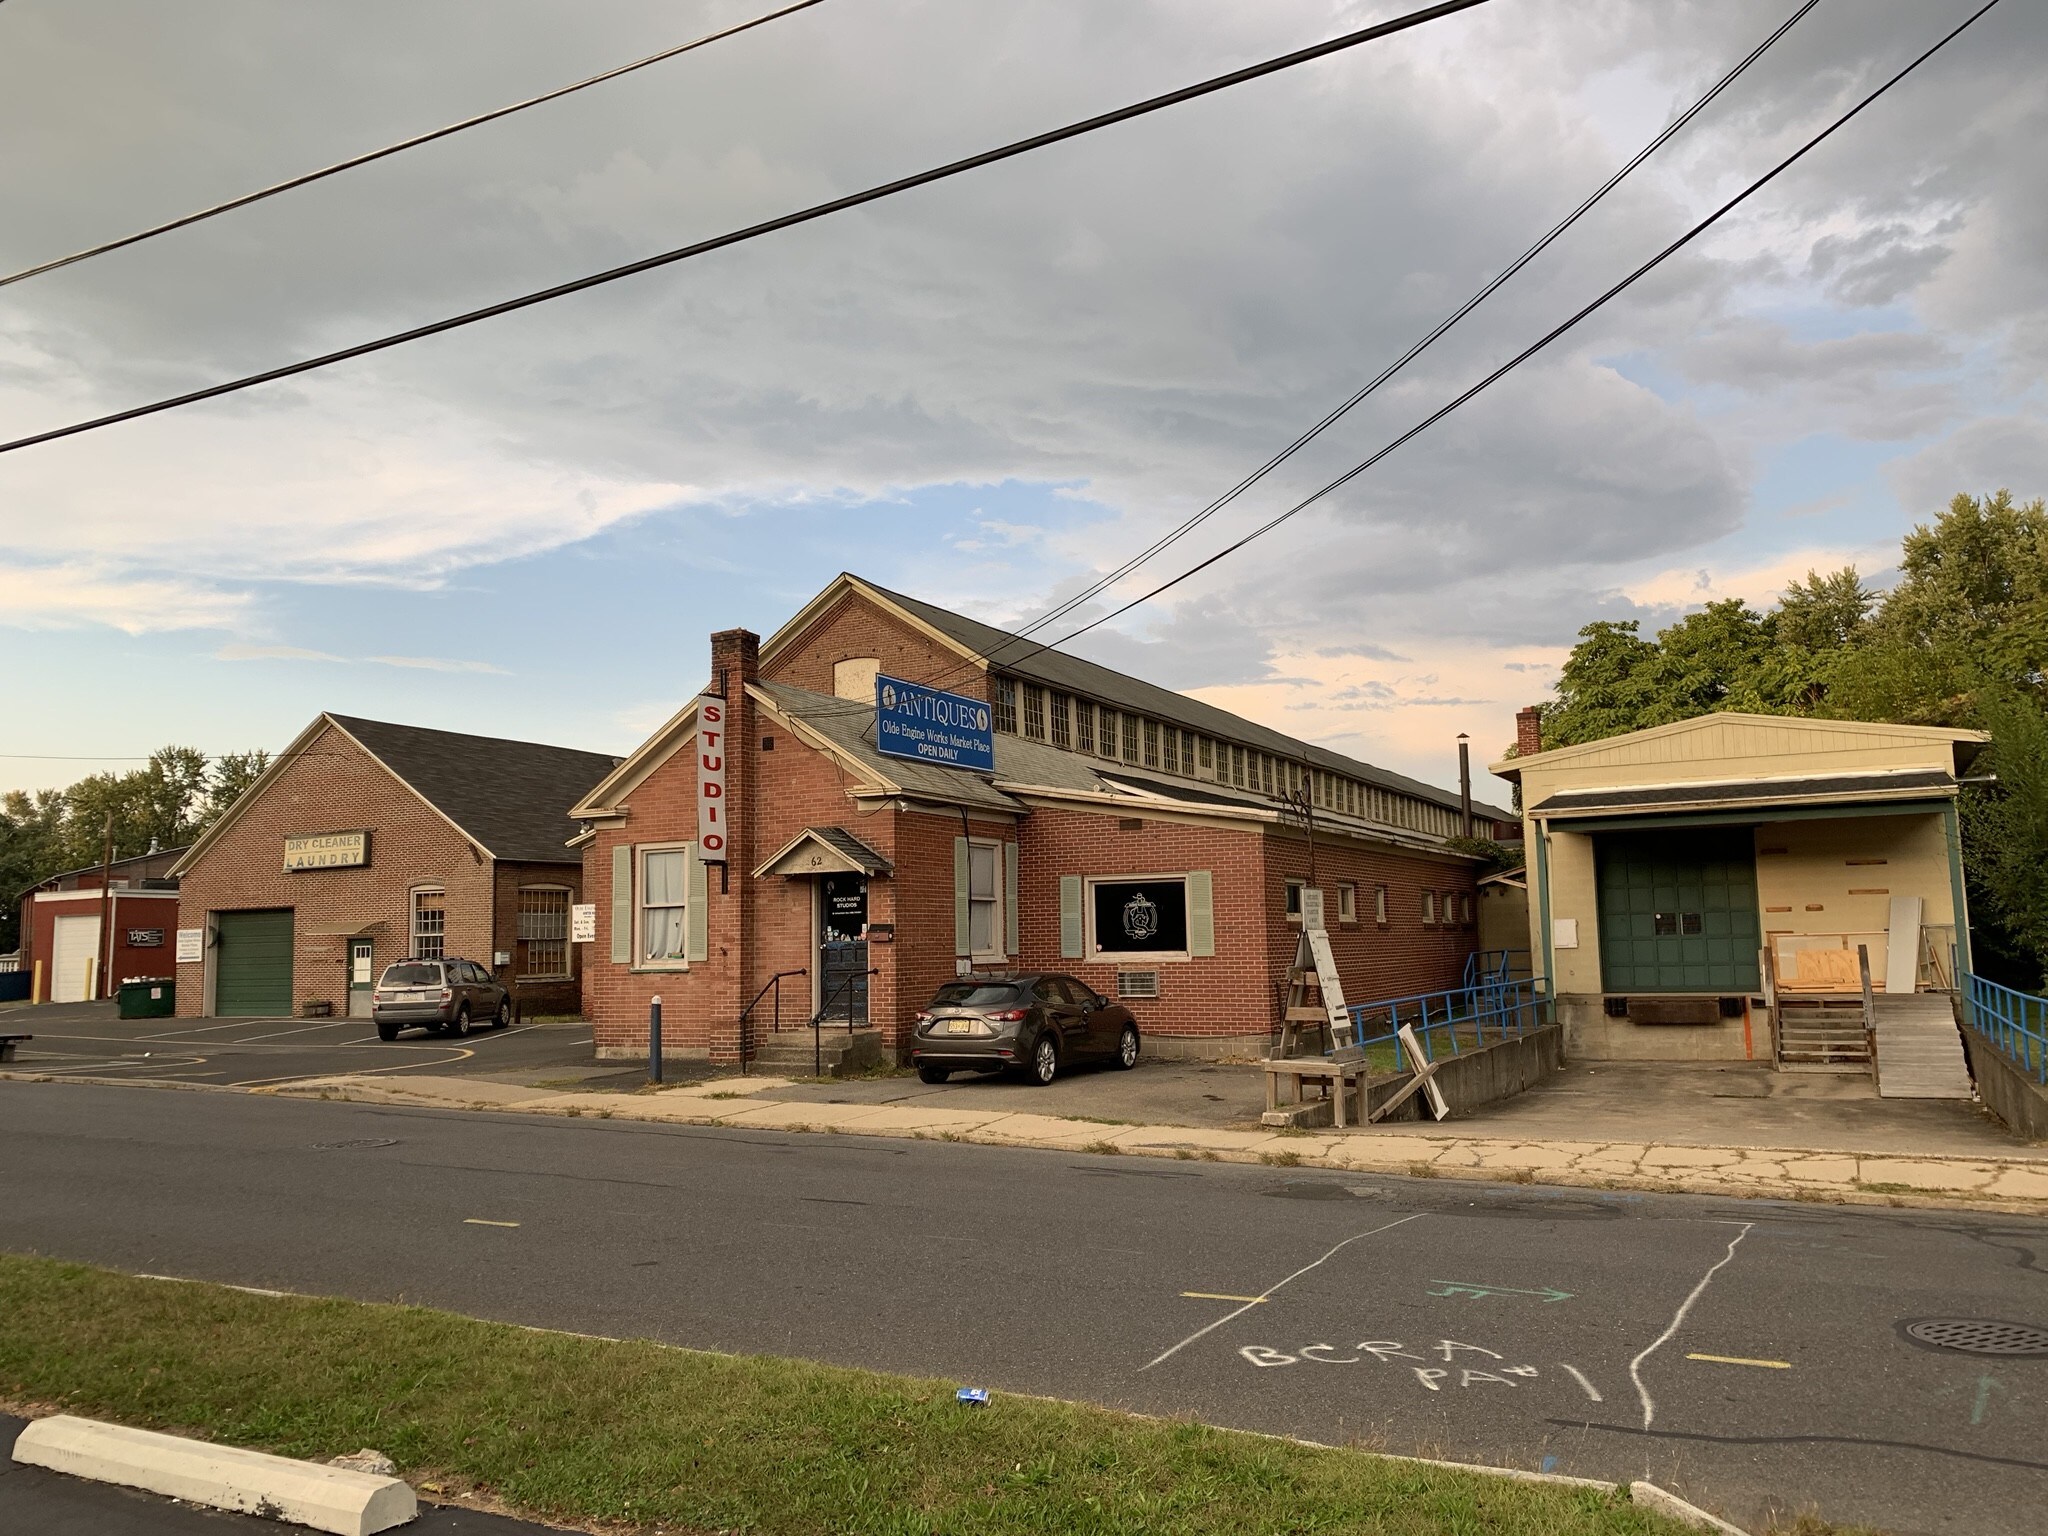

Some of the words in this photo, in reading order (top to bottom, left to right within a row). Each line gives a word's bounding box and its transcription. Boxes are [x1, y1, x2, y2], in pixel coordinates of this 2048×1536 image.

[898, 691, 977, 730] ANTIQUES
[882, 720, 900, 735] Olde
[901, 724, 925, 740] Engine
[926, 728, 949, 745] Works
[949, 733, 973, 750] Market
[973, 738, 991, 753] Place
[918, 743, 938, 757] OPEN
[938, 747, 959, 760] DAILY
[702, 705, 724, 851] STUDIO
[288, 839, 309, 851] DRY
[311, 835, 361, 849] CLEANER
[286, 852, 360, 868] LAUNDRY
[811, 856, 822, 867] 62
[1238, 1338, 1504, 1367] BCRA
